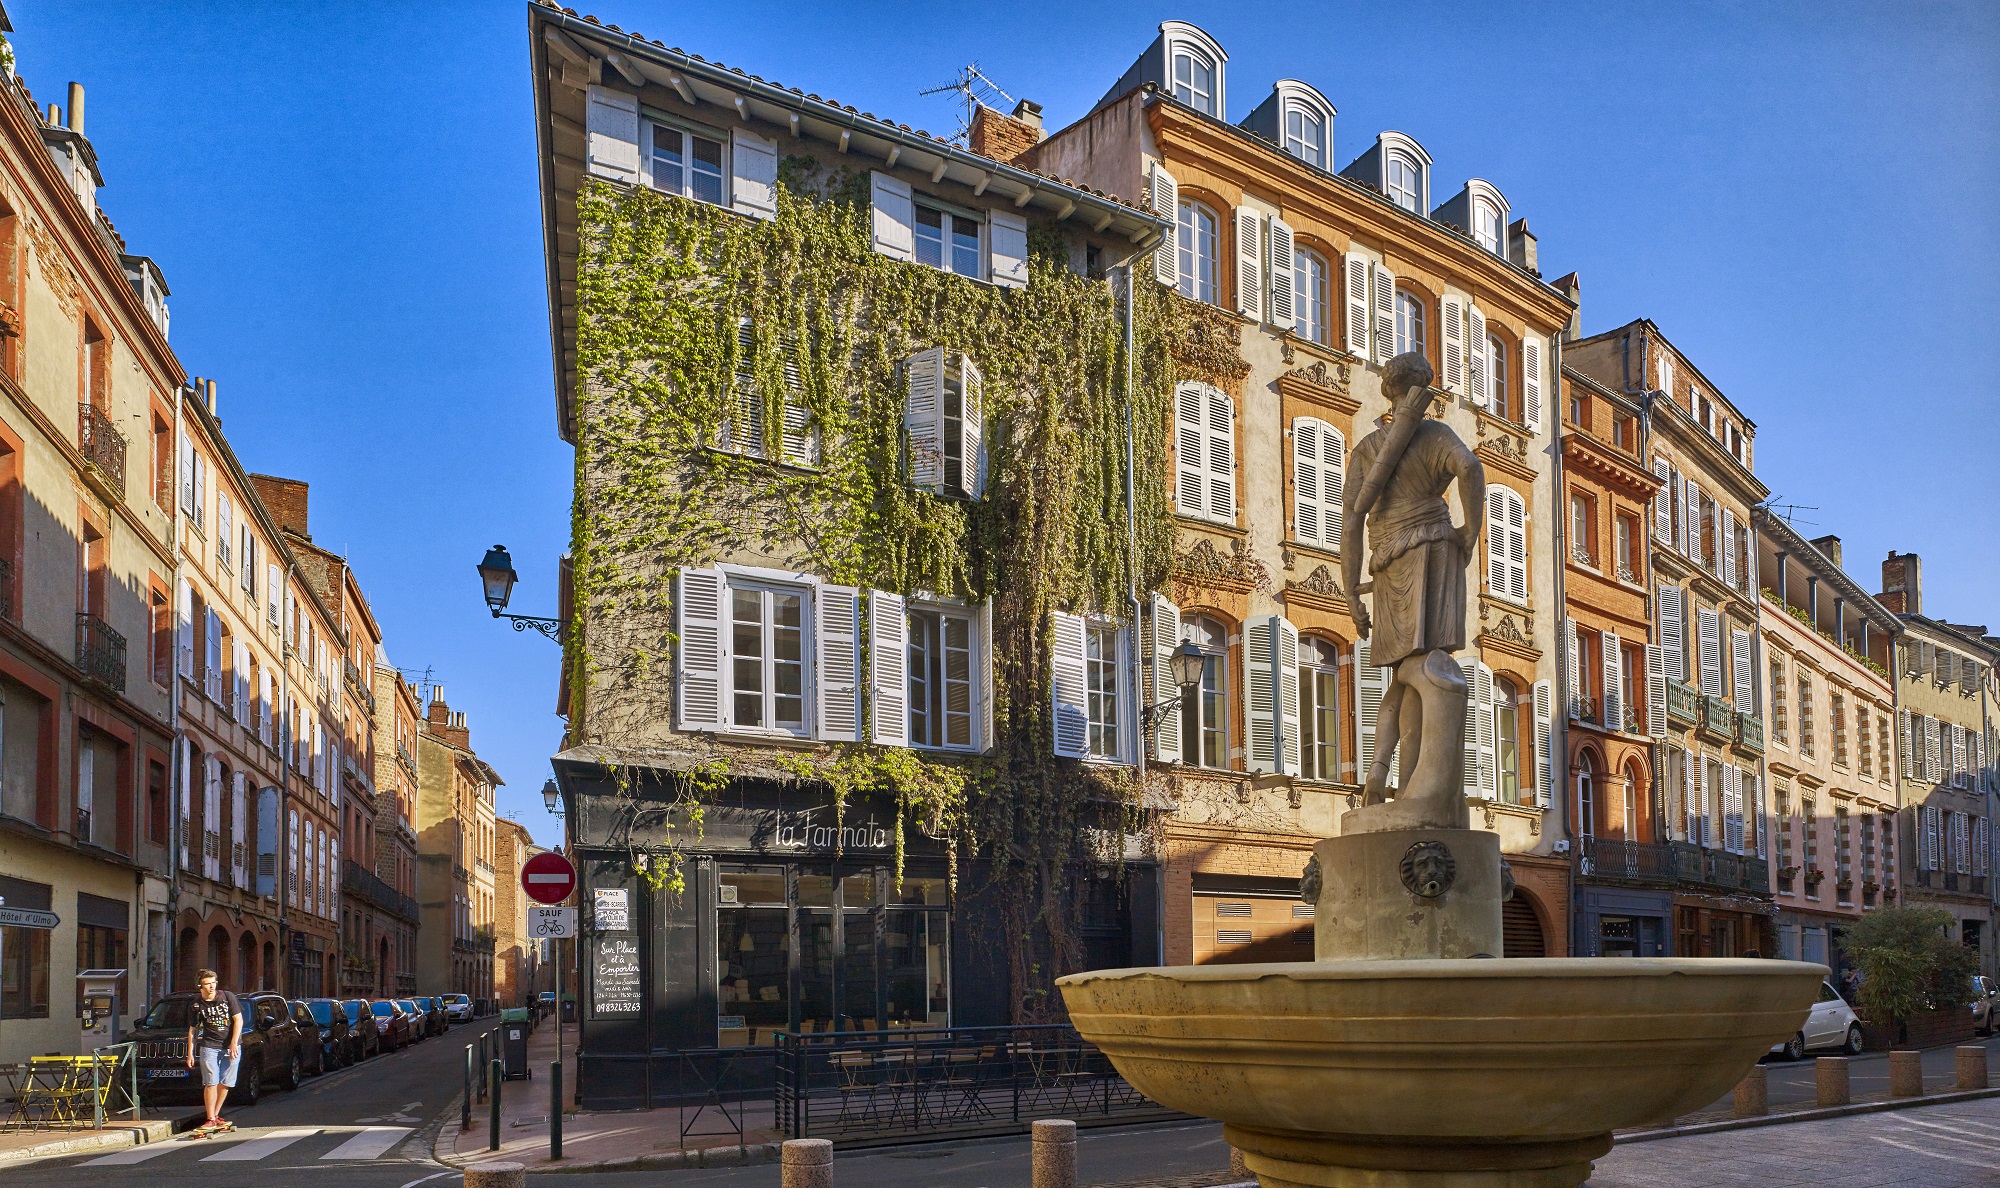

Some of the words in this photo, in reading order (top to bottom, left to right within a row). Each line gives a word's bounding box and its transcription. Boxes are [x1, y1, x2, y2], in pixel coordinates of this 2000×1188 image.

[775, 808, 795, 847] la
[797, 801, 887, 848] Farnata
[0, 911, 22, 922] Hôtel
[539, 909, 563, 917] SAUF
[600, 942, 616, 955] Sur
[616, 940, 637, 954] Place
[611, 954, 619, 963] et
[620, 955, 625, 963] à
[600, 962, 640, 978] Emporter
